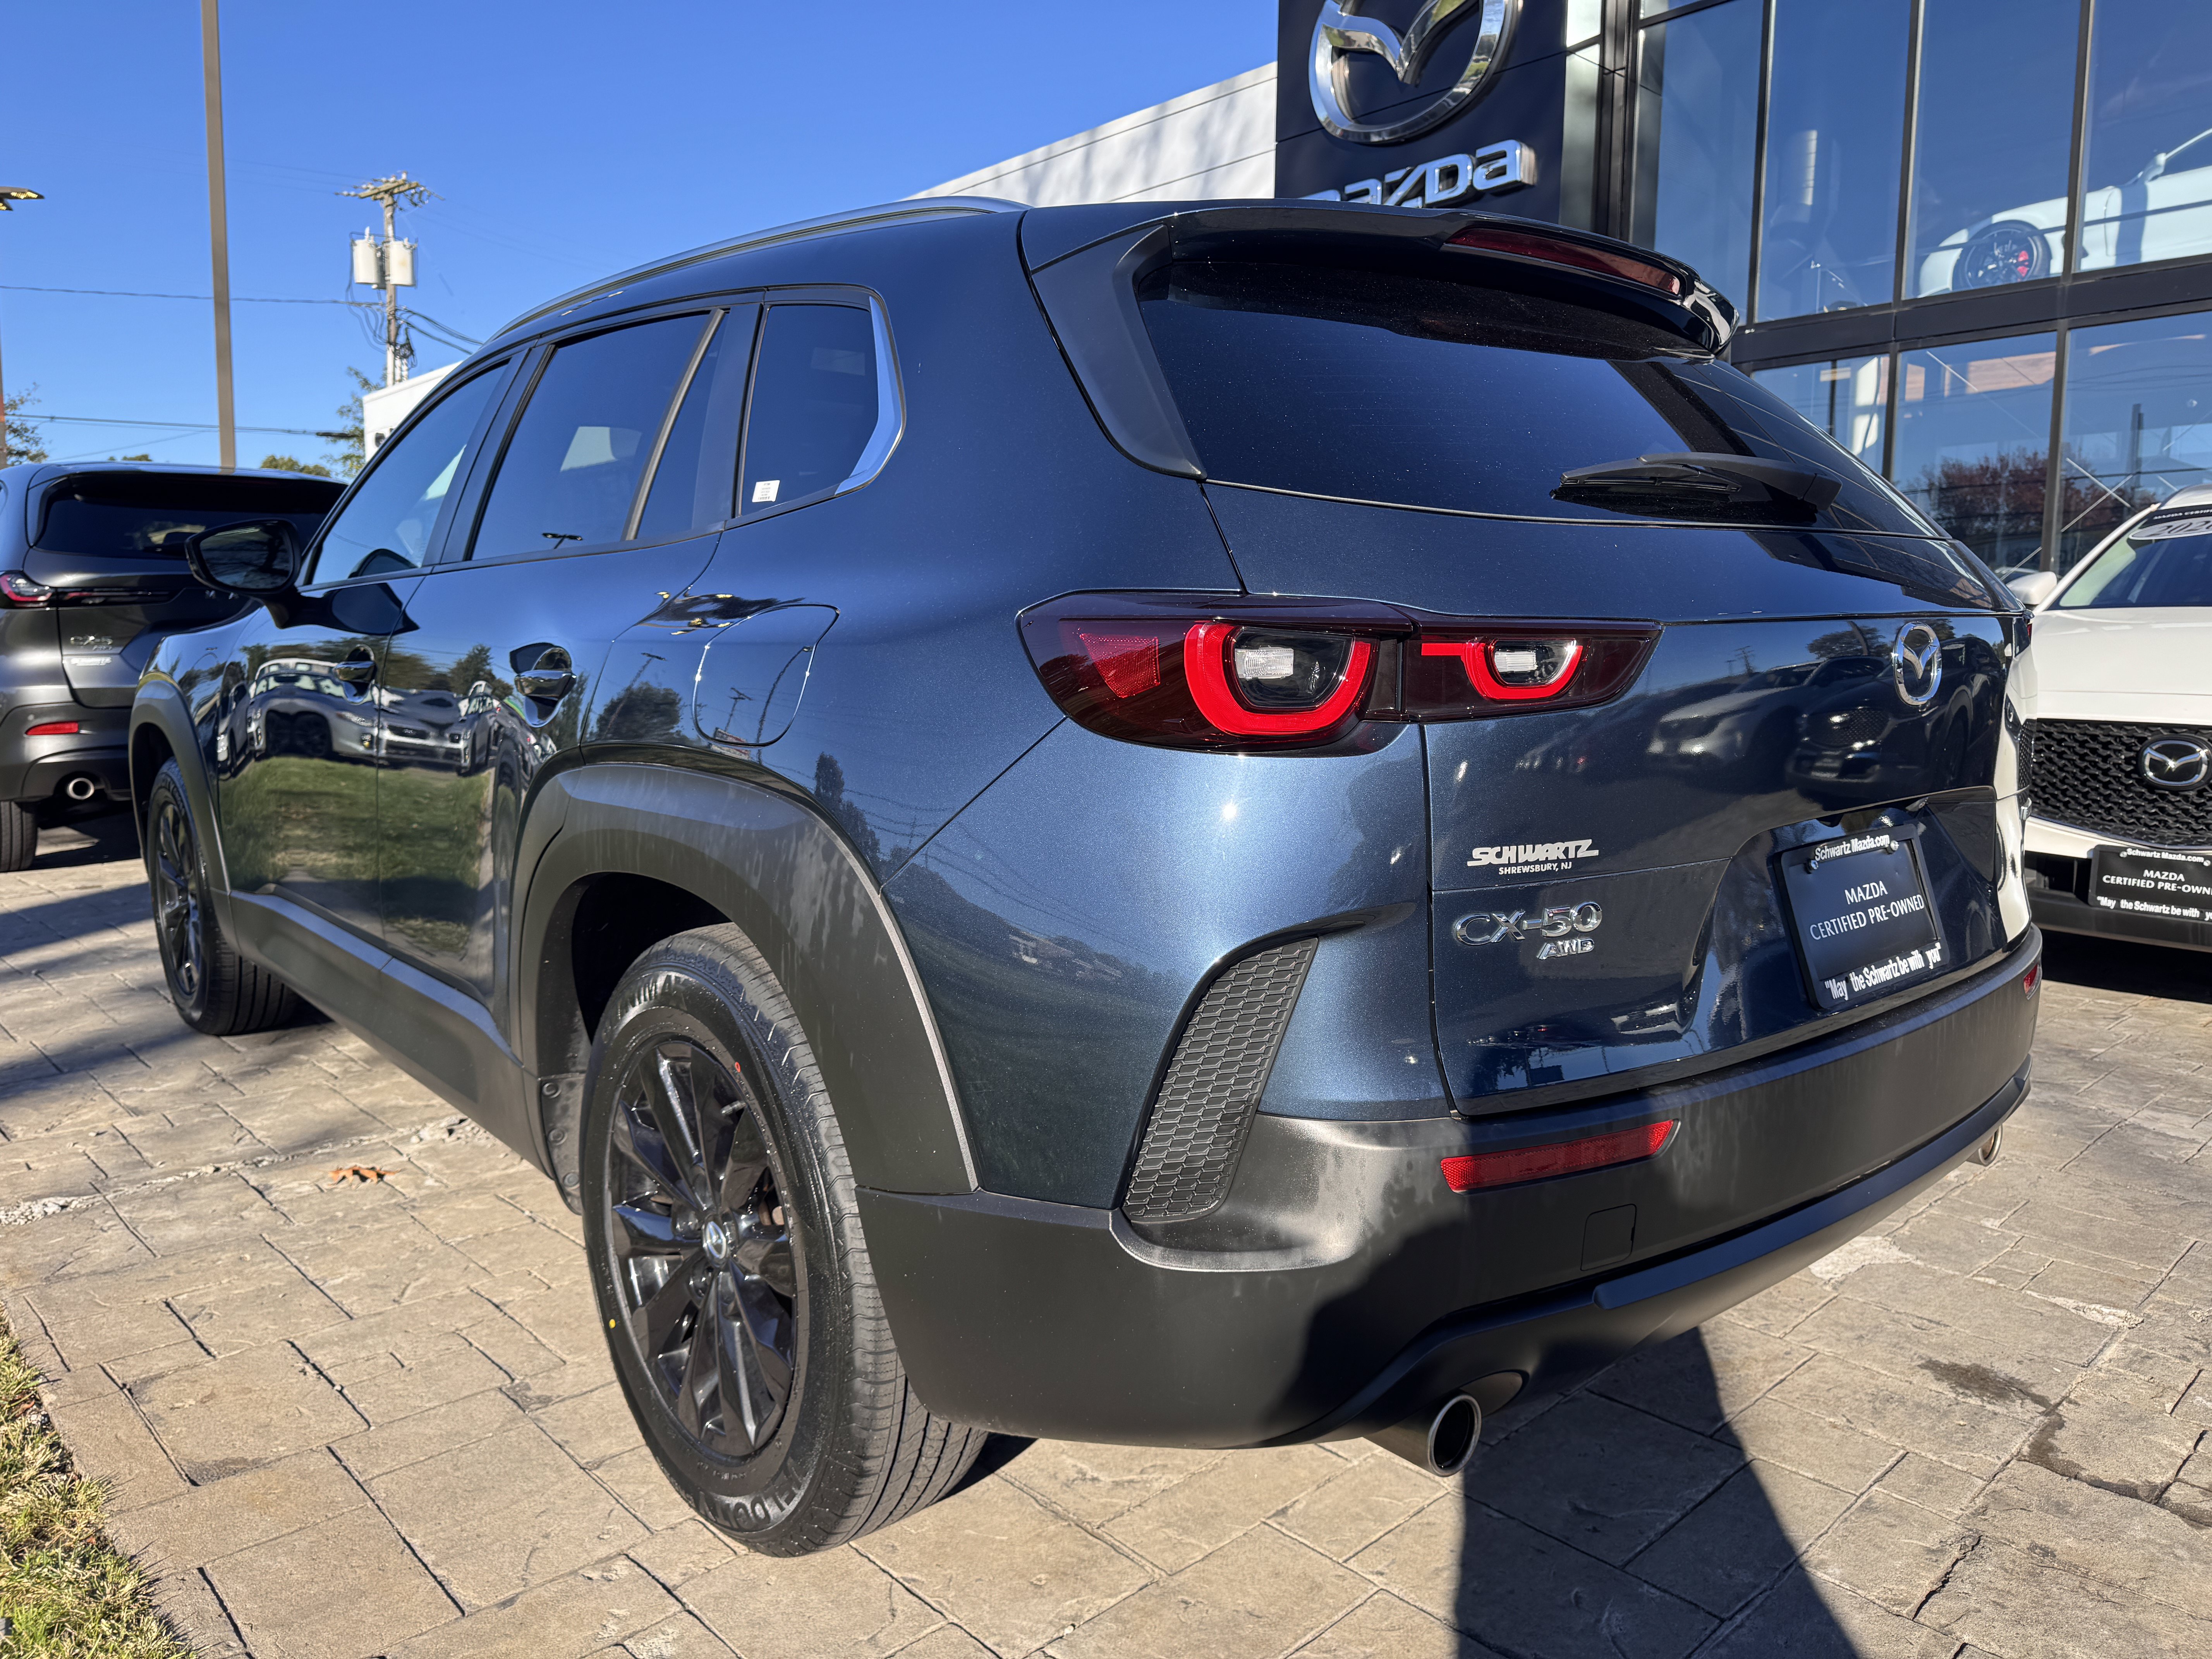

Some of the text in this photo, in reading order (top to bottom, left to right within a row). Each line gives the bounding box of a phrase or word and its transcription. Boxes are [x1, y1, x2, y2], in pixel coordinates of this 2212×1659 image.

[1467, 839, 1599, 867] SCHWARTZ
[1815, 835, 1890, 861] Schwartz Mazda.com
[2126, 848, 2204, 863] Schwartz Mazda.com
[1499, 862, 1572, 875] SHREWSBURY, NJ
[2143, 869, 2185, 882] MAZDA
[1844, 880, 1888, 905] MAZDA
[2102, 875, 2212, 895] CERTIFIED PRE-OWN
[1810, 894, 1925, 940] CERTIFIED PRE-OWNED
[2120, 899, 2133, 910] the
[2134, 901, 2170, 914] Schwartz
[2171, 905, 2182, 916] be
[2182, 907, 2200, 918] with
[1454, 901, 1602, 946] CX-50
[1536, 938, 1595, 960] AWD
[1849, 971, 1866, 992] the
[1863, 959, 1901, 987] Schwartz
[1896, 956, 1910, 975] be
[1906, 949, 1925, 971] with
